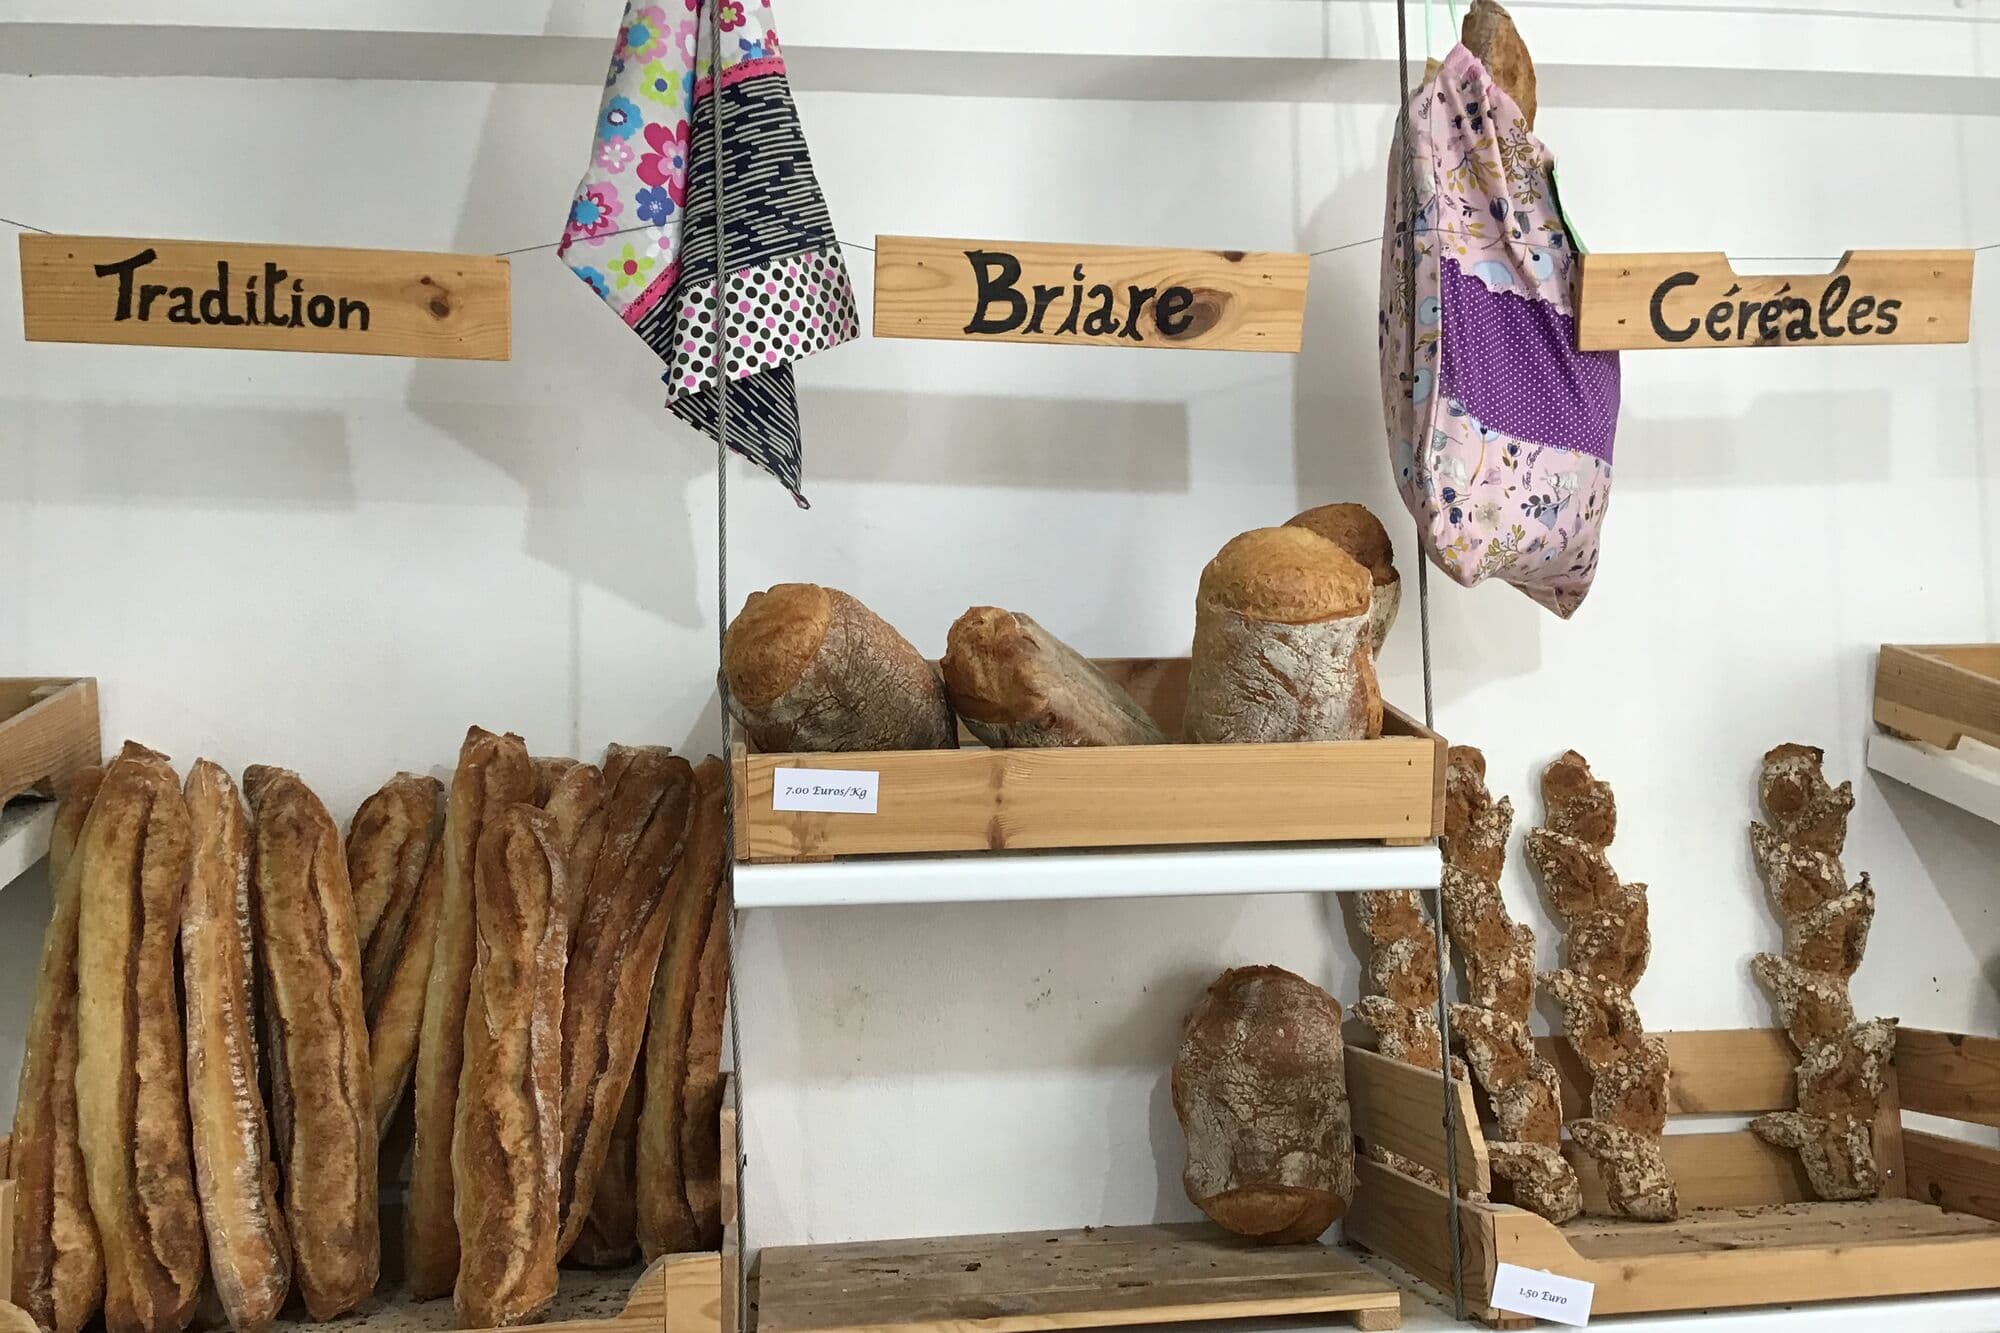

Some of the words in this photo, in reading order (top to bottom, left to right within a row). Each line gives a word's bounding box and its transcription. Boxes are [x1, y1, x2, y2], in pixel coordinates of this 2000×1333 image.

[93, 248, 370, 332] Tradition
[963, 249, 1196, 342] Briare
[1649, 271, 1902, 343] Céréales
[785, 786, 810, 796] 7.00
[812, 785, 868, 800] Euros/Kg
[1519, 1287, 1539, 1298] 1.50
[1541, 1291, 1568, 1305] Euro
